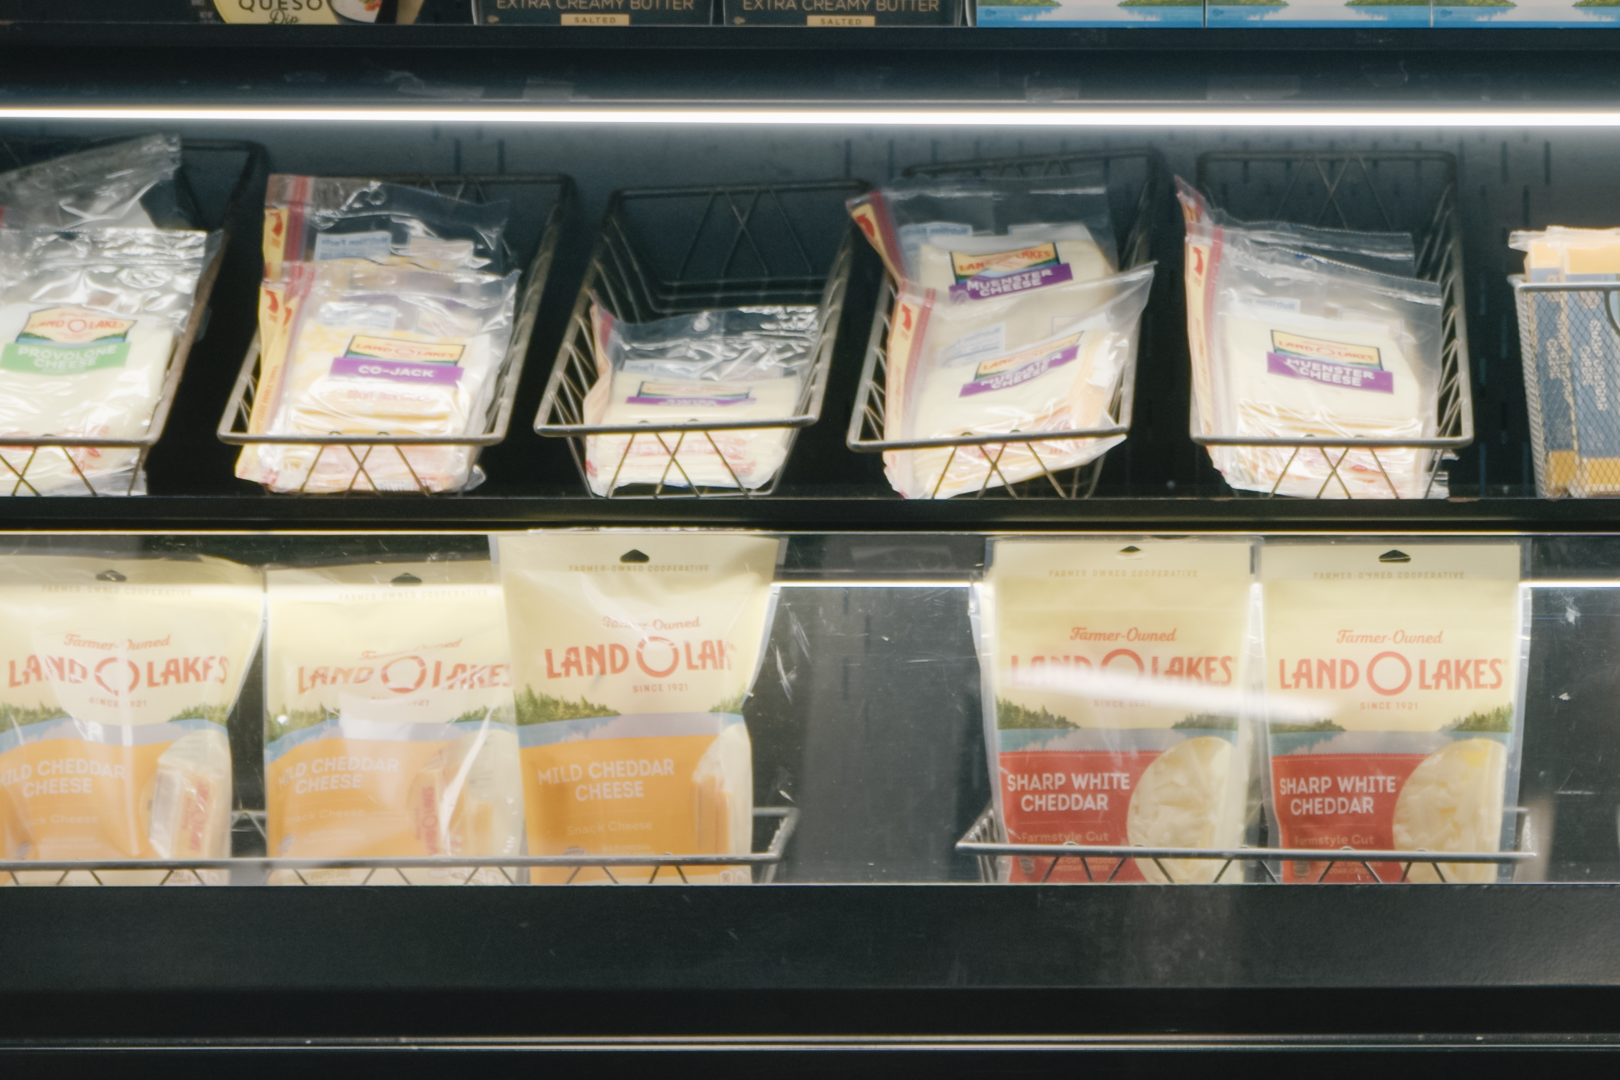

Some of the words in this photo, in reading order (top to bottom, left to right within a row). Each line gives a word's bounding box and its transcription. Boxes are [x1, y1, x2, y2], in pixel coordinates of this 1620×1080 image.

[966, 270, 1052, 291] MUENSTER
[980, 280, 1042, 297] CHEESE
[18, 345, 117, 361] PROVOLONE
[34, 357, 97, 369] CHEESE
[358, 364, 435, 378] CO-JACK
[1336, 629, 1444, 645] Farmer-Owned
[1279, 658, 1360, 690] LAND
[1418, 658, 1503, 690] LAKES
[538, 763, 583, 786] MILD
[588, 758, 675, 780] CHEDDAR
[575, 780, 645, 802] CHEESE
[1279, 777, 1332, 796] SHARP
[1337, 775, 1397, 794] WHITE
[1290, 796, 1375, 815] CHEDDAR
